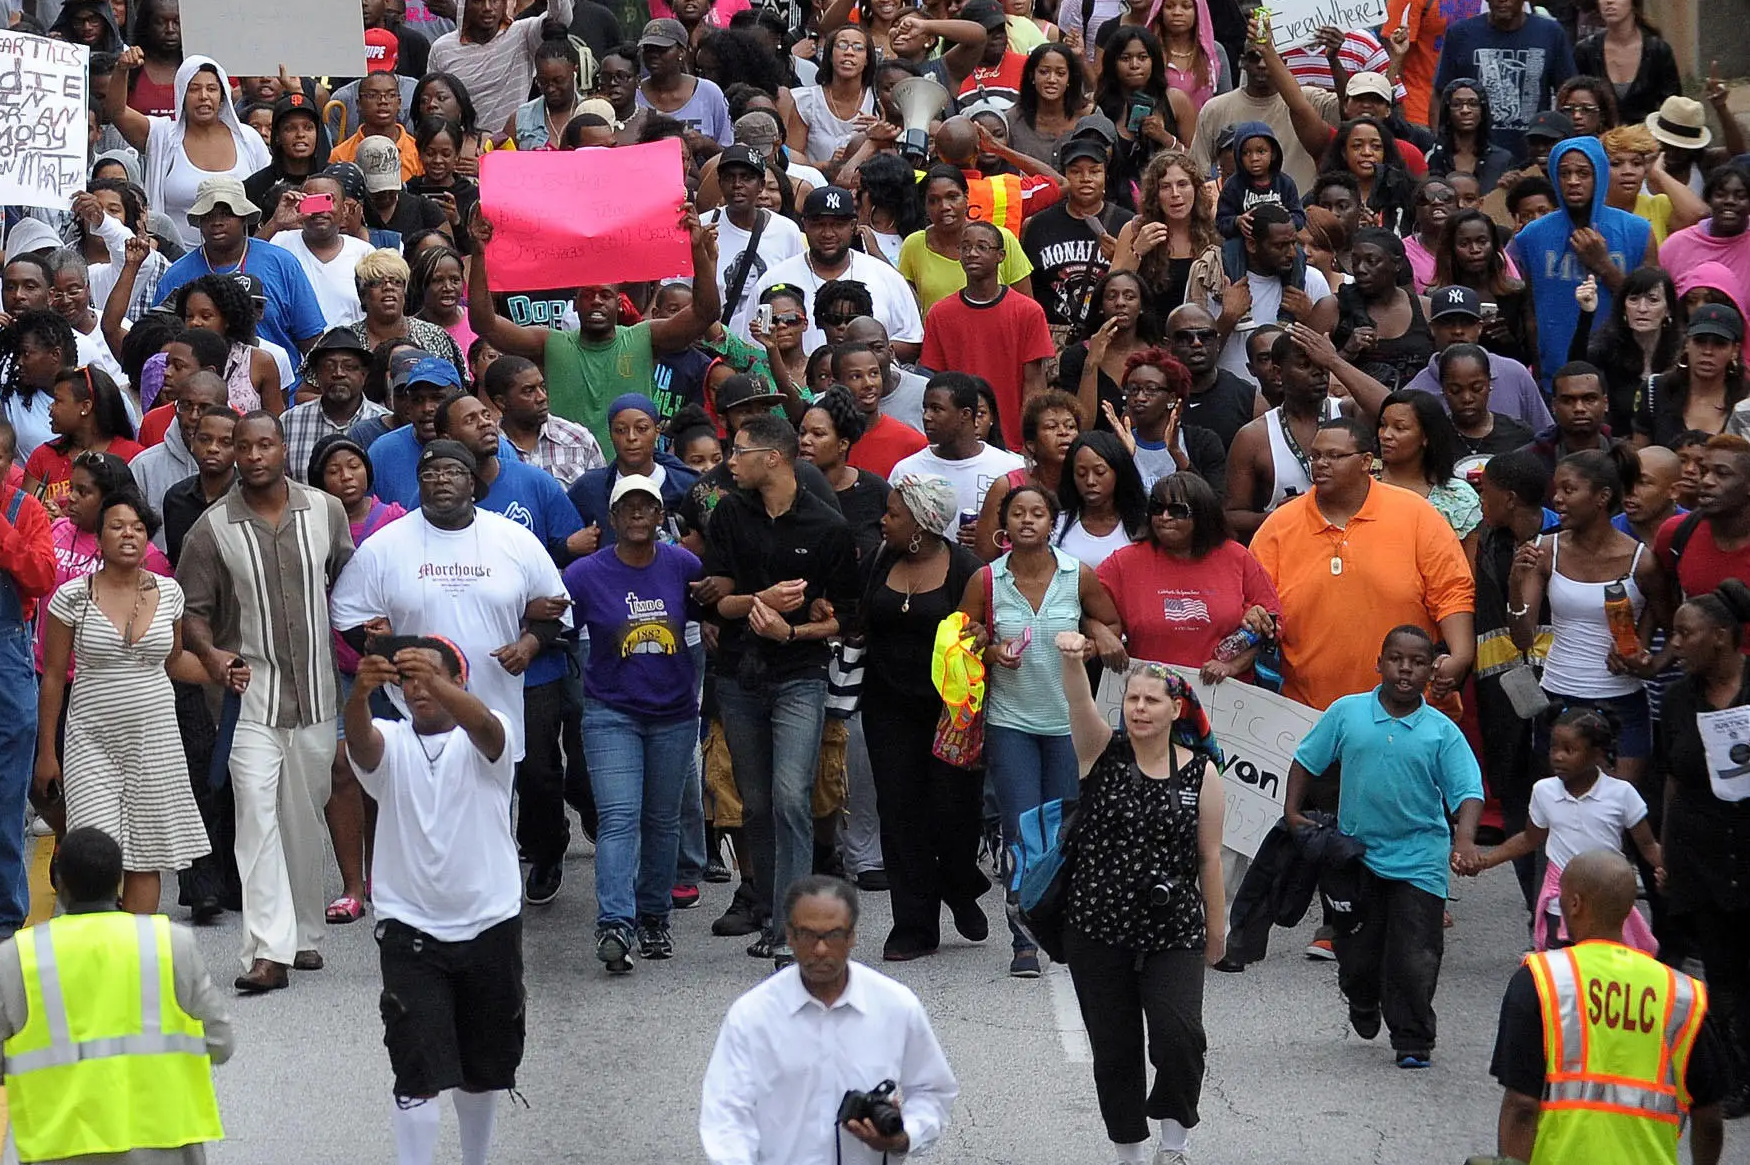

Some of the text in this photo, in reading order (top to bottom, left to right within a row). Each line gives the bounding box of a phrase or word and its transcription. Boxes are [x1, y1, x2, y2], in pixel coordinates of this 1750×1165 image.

[826, 193, 840, 209] NY
[1448, 289, 1464, 303] NY
[418, 561, 491, 579] Morehouse
[1588, 978, 1657, 1034] SCLC
